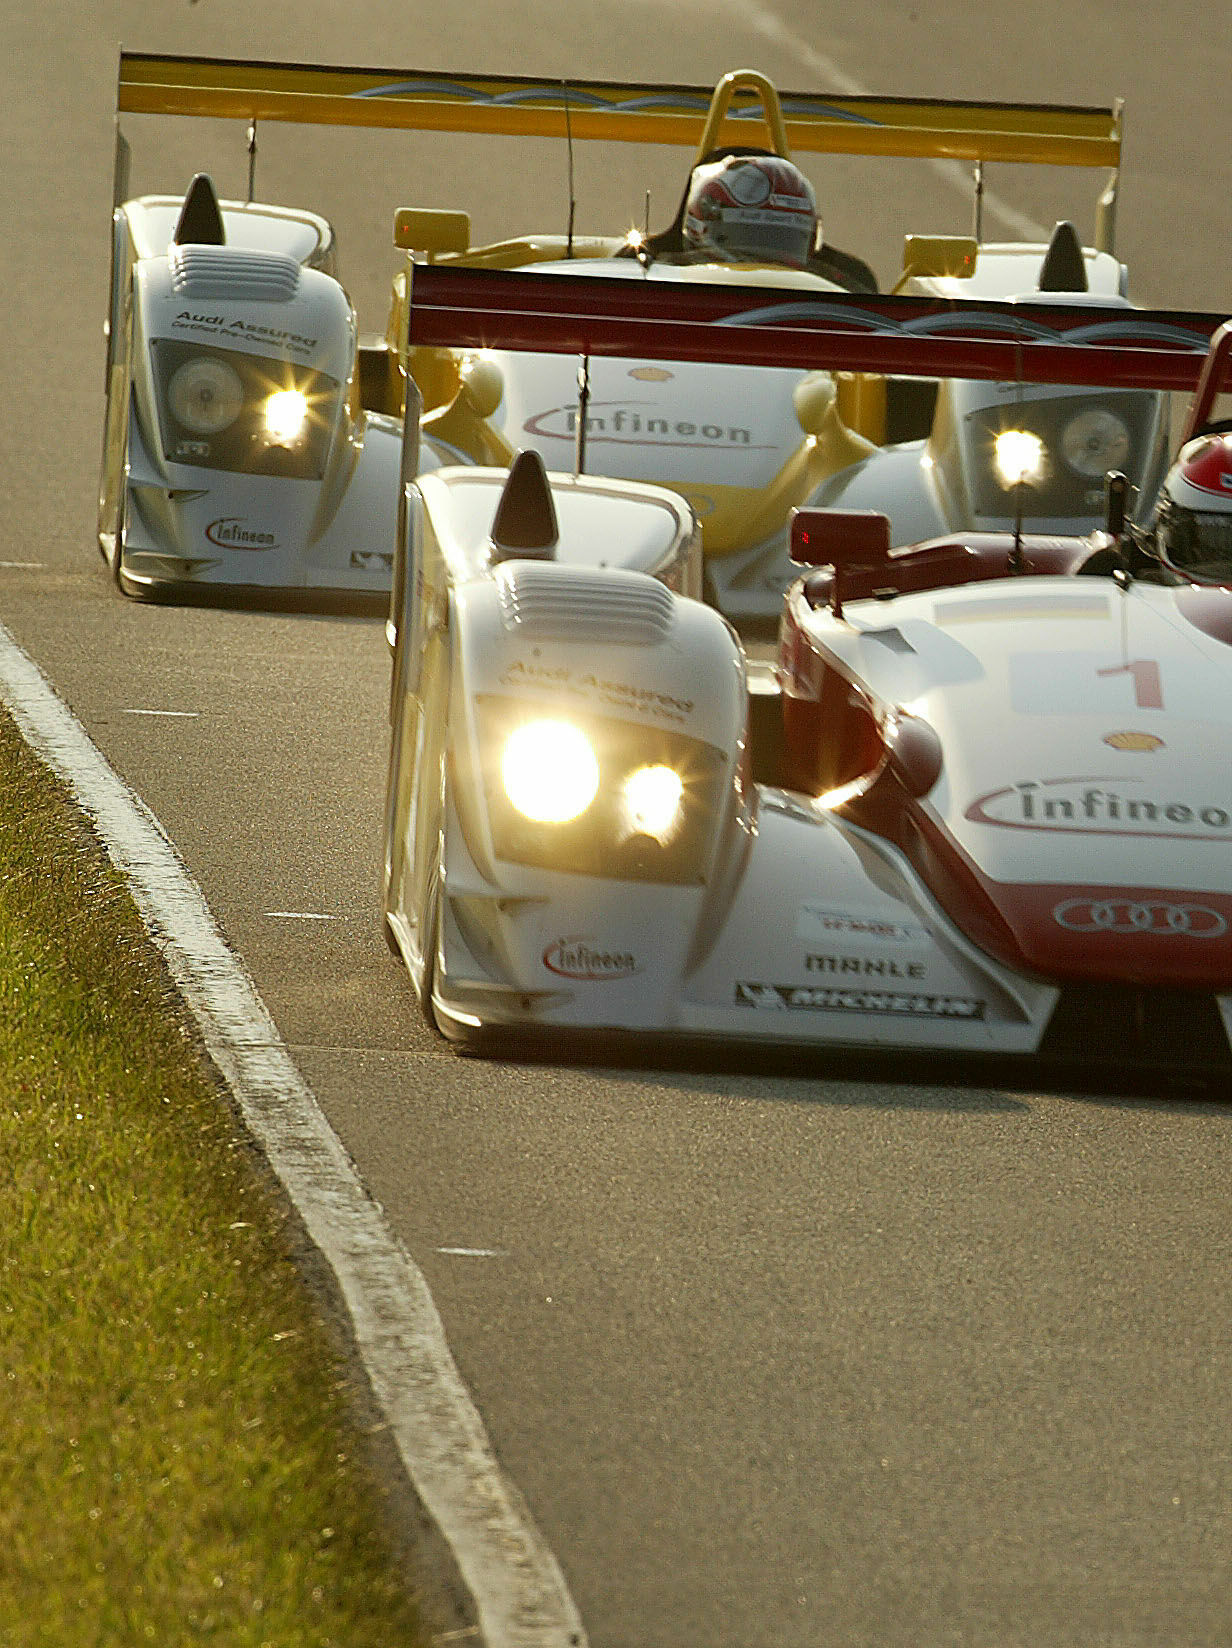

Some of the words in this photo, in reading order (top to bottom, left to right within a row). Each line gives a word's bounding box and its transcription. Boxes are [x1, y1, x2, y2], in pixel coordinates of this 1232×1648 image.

[176, 311, 225, 325] Audi
[229, 320, 318, 347] Assured
[1097, 660, 1165, 711] 1
[805, 953, 926, 980] MAHLE
[790, 988, 978, 1017] MICHELIN
